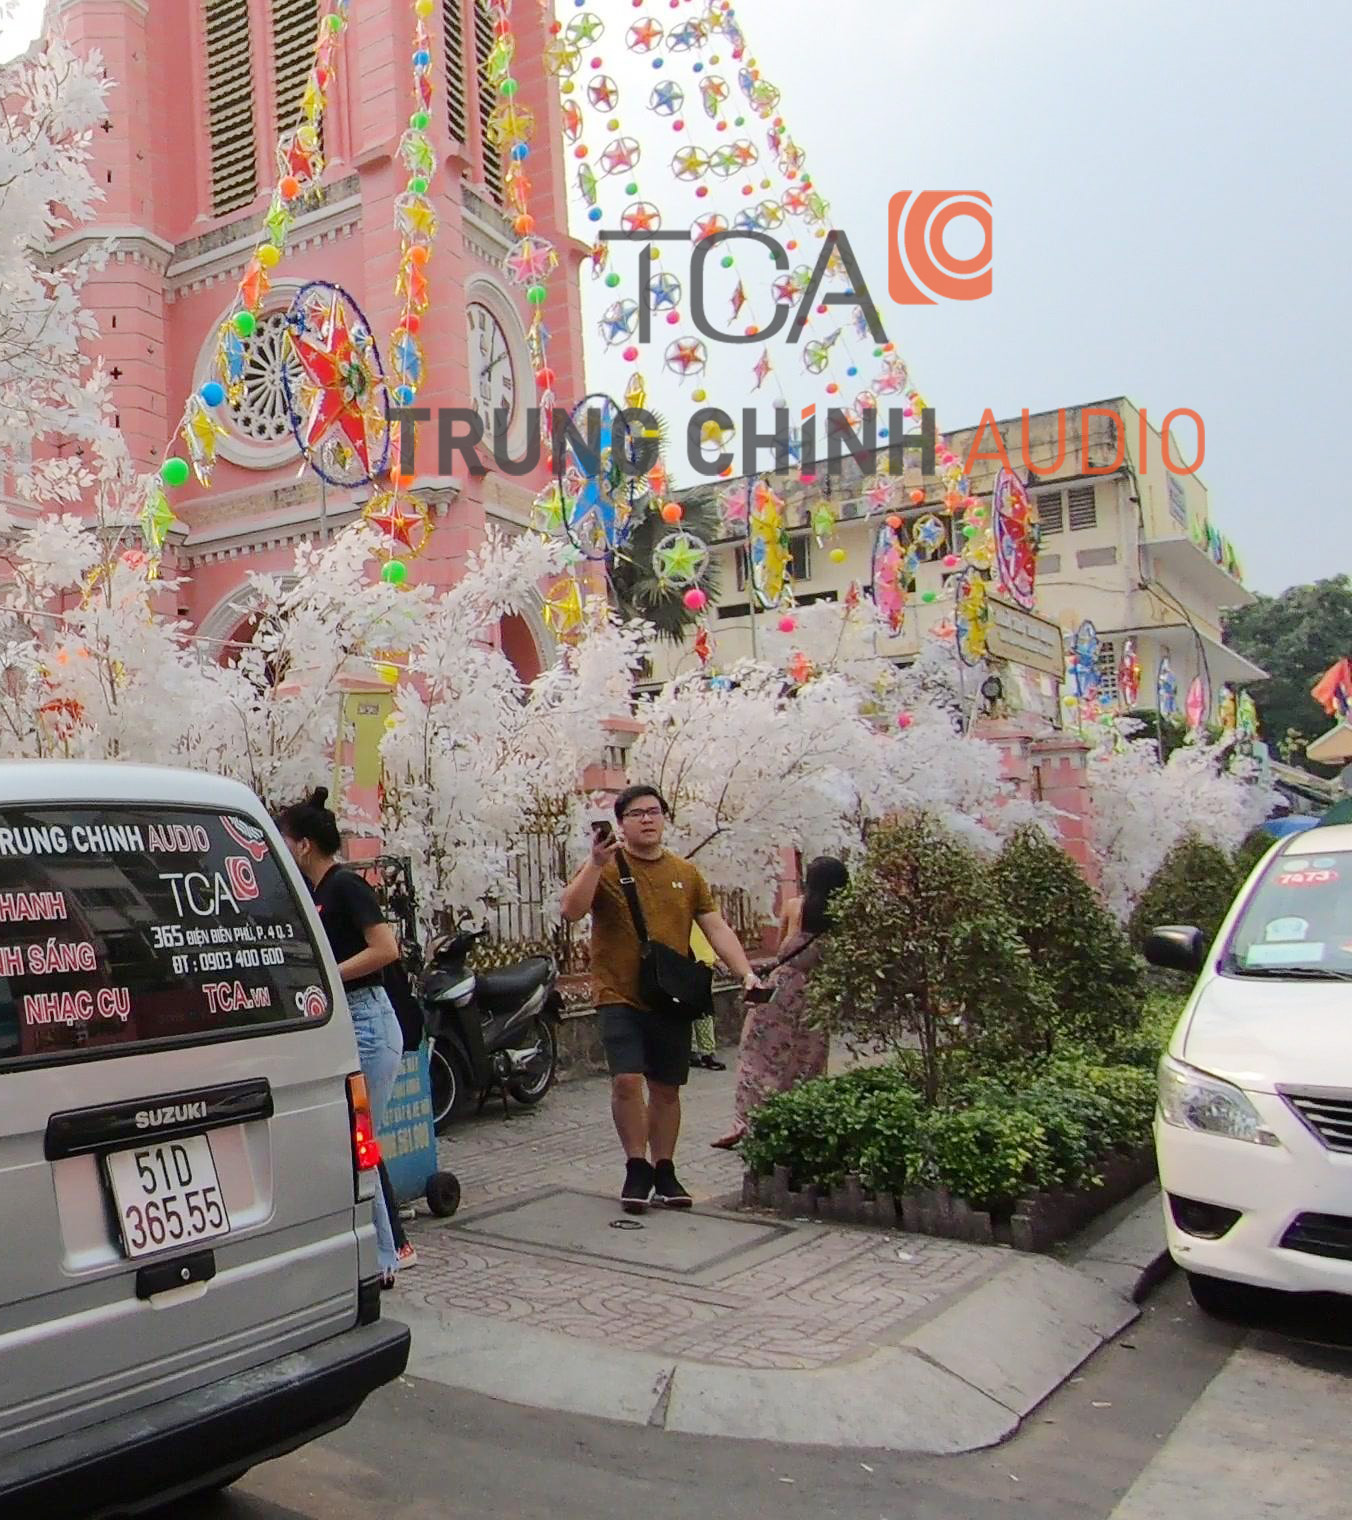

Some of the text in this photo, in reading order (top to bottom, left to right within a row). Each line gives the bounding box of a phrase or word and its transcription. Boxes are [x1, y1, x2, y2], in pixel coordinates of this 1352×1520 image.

[148, 824, 210, 853] AUDIO
[159, 871, 241, 918] TCA
[150, 924, 185, 949] 365
[285, 923, 294, 938] 3
[27, 937, 97, 975] SÁNG
[199, 951, 233, 972] 0903
[235, 948, 260, 968] 400
[260, 946, 285, 966] 600
[24, 987, 131, 1026] NHẠC CỤ
[202, 981, 271, 1013] TCA.VN
[135, 1101, 208, 1129] SUZUKI
[134, 1144, 193, 1195] 51D
[125, 1186, 223, 1249] 365.55
